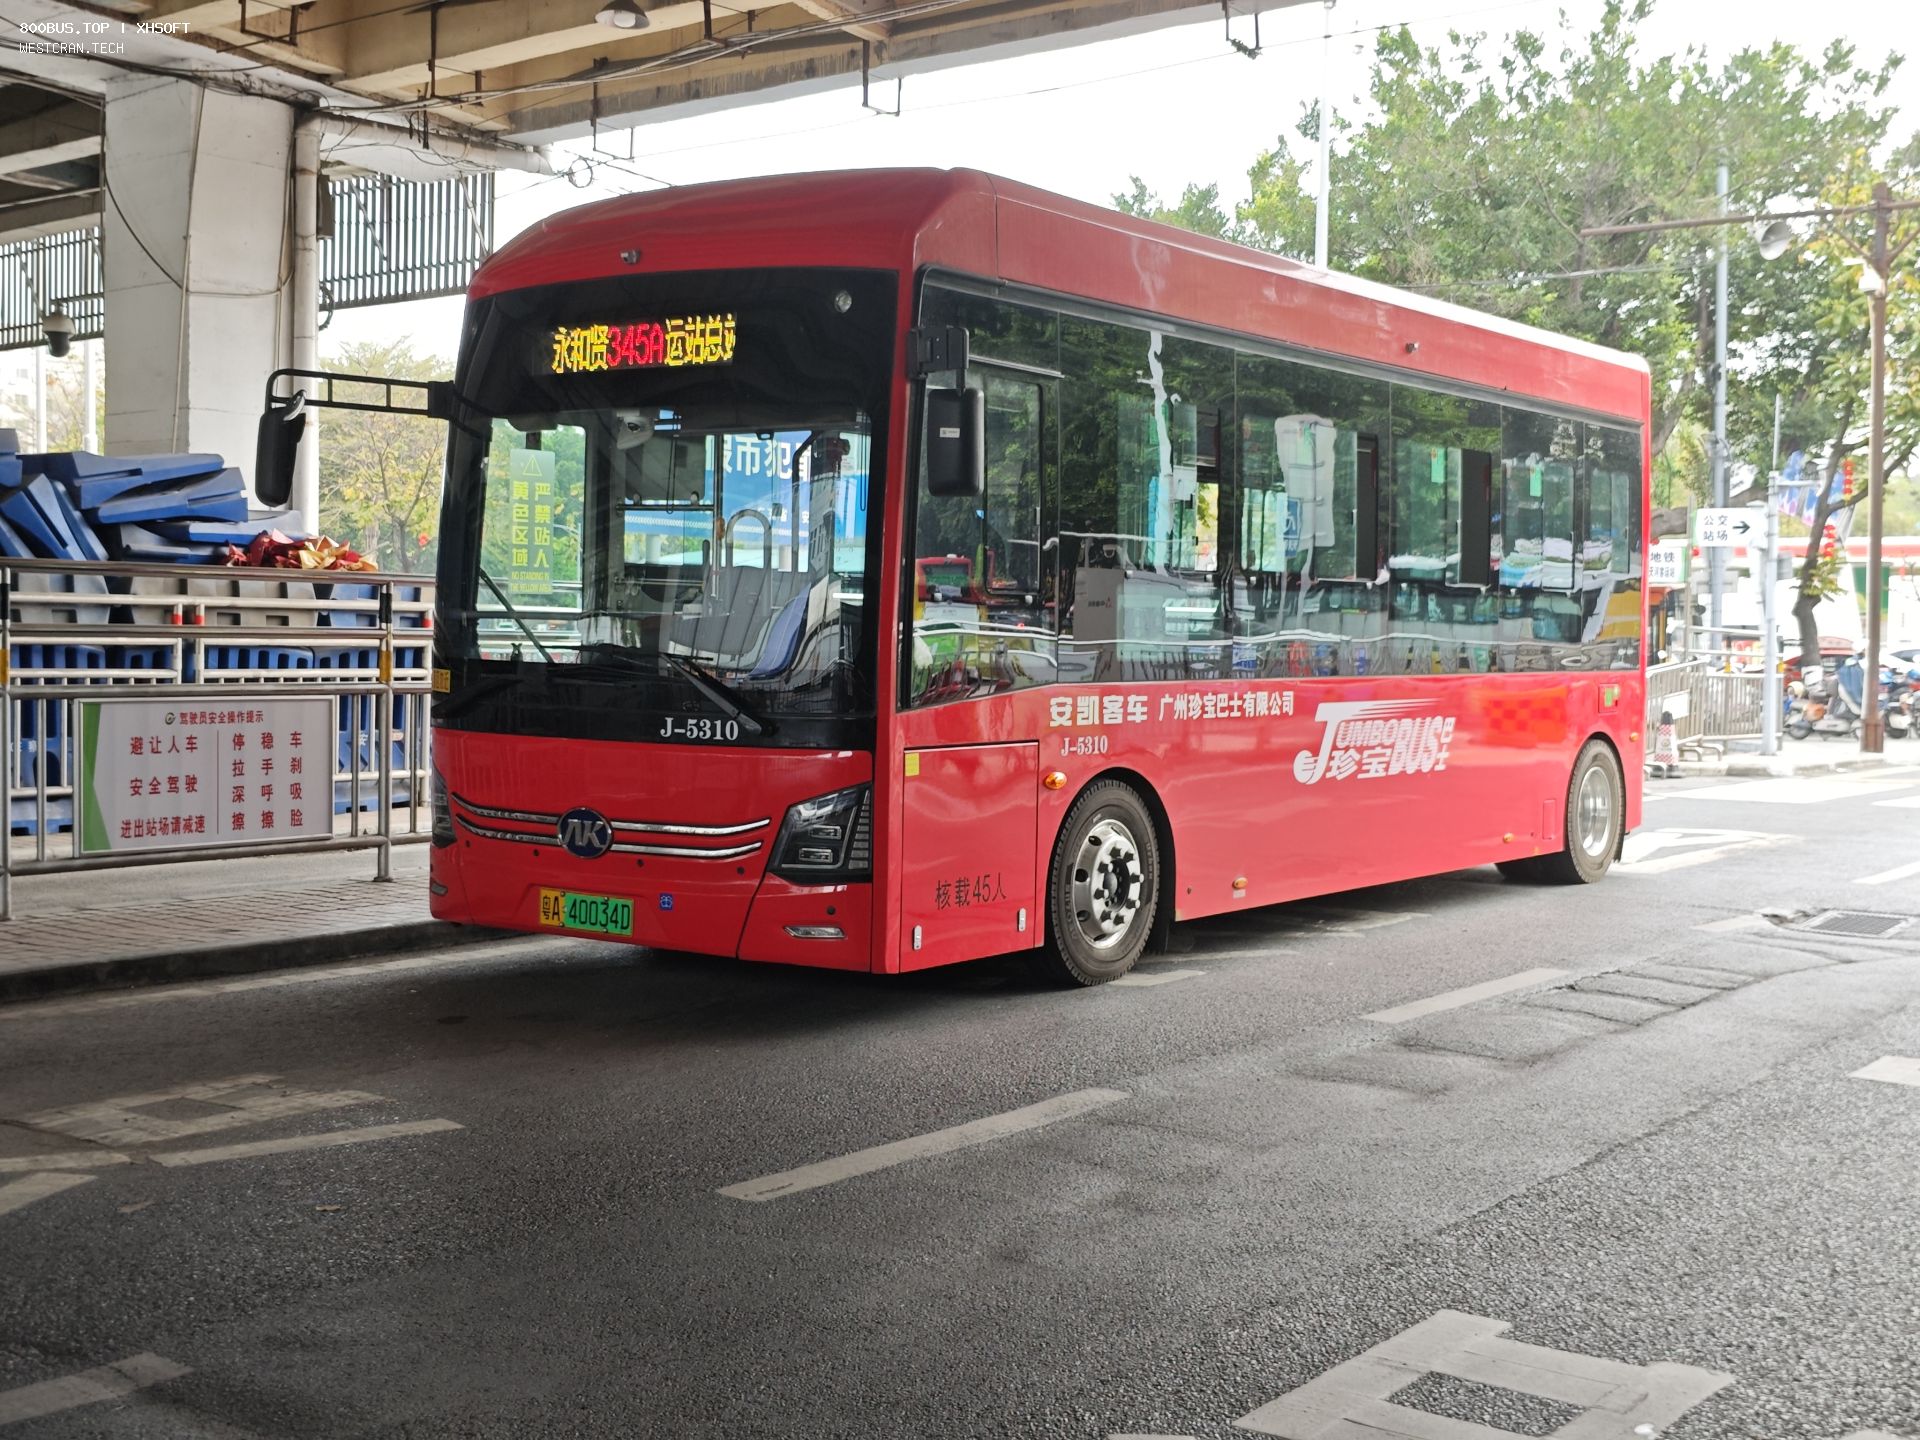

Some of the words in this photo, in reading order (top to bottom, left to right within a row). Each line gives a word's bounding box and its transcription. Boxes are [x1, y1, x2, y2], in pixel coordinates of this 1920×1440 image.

[534, 482, 551, 568] 严禁站人
[1703, 515, 1728, 526] 公交
[1703, 530, 1728, 541] 站场
[1650, 551, 1675, 563] 地铁
[179, 710, 264, 726] 驾驶员安全操作提示
[1049, 695, 1148, 727] 安凯客车
[1158, 690, 1294, 721] 广州珍宝巴士有限公司
[659, 717, 739, 741] J-5310
[130, 734, 199, 756] 避让人车
[1061, 735, 1109, 757] J-5310
[1325, 748, 1391, 781] 珍宝
[130, 774, 198, 797] 安全驾驶
[120, 815, 206, 839] 进出站场请减速
[934, 871, 1007, 910] 核载45人
